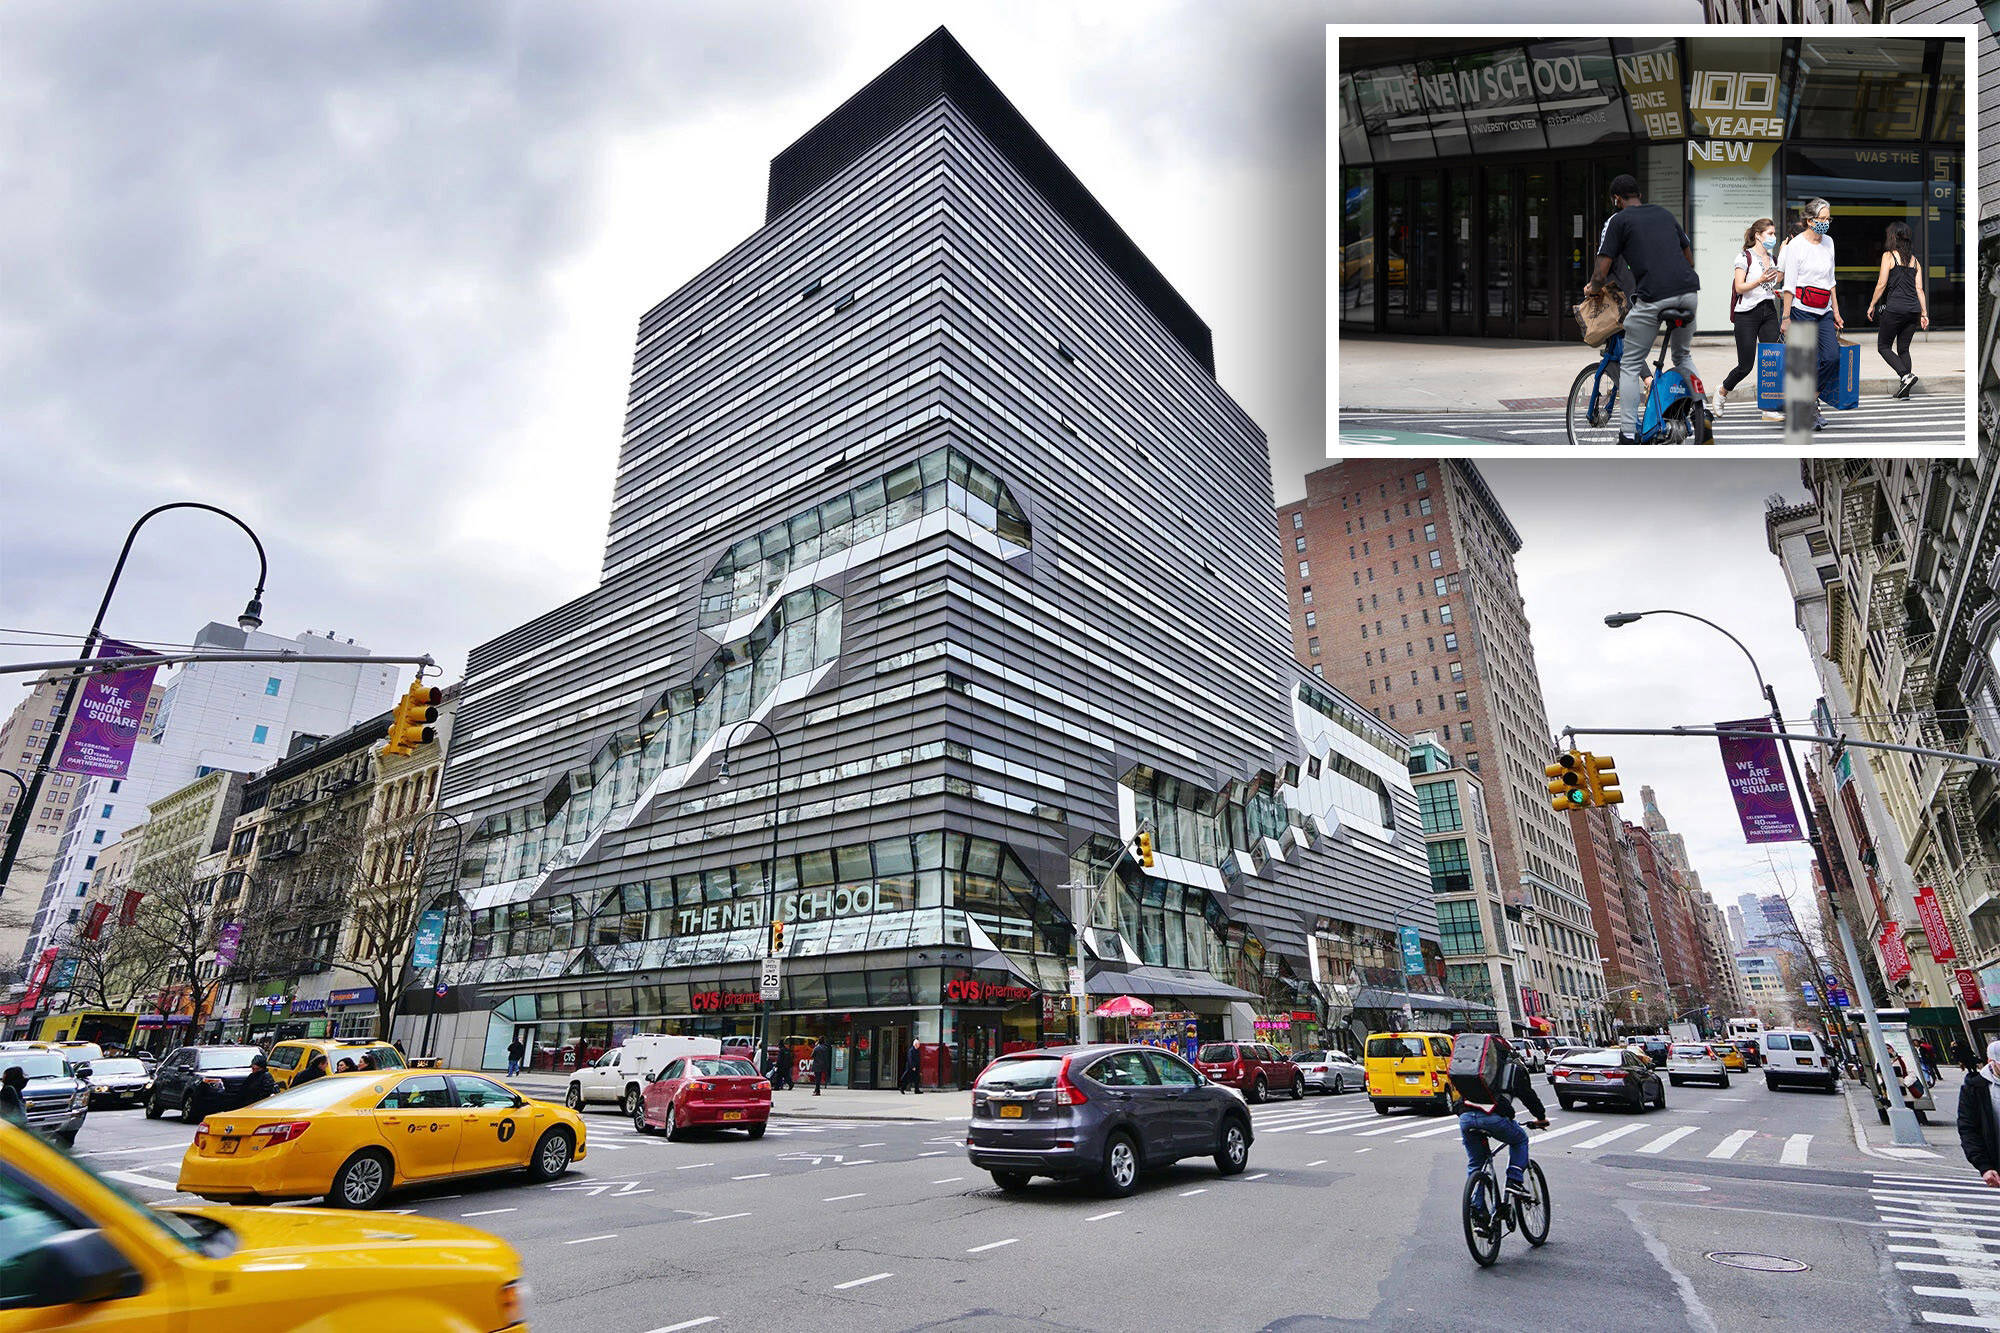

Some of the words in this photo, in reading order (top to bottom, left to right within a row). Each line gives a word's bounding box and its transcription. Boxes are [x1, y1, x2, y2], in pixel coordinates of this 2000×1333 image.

[1616, 52, 1675, 86] NEW
[1374, 78, 1424, 113] THE
[1420, 69, 1480, 108] NEW
[1483, 56, 1599, 101] SCHOOL
[1689, 71, 1777, 111] 100
[1630, 91, 1668, 110] SINCE
[1470, 121, 1508, 134] UNIVERSITY
[1509, 119, 1537, 131] CENTER
[1644, 112, 1682, 137] 1919
[1705, 116, 1784, 136] YEARS
[1688, 140, 1753, 162] NEW
[1855, 151, 1887, 163] WAS
[1891, 152, 1920, 164] THE
[1934, 187, 1952, 198] OF
[100, 684, 119, 697] WE
[83, 699, 122, 715] UNION
[107, 696, 132, 709] ARE
[89, 710, 138, 728] SQUARE
[75, 741, 110, 751] CELEBRATING
[80, 747, 94, 755] 40
[67, 757, 118, 769] PARTNERSHIPS
[84, 755, 124, 765] COMMUNITY
[1736, 761, 1754, 770] WE
[1749, 768, 1771, 777] ARE
[1731, 777, 1766, 787] UNION
[1741, 783, 1786, 795] SQUARE
[679, 906, 719, 934] THE
[721, 898, 780, 928] NEW
[784, 884, 894, 922] SCHOOL
[763, 974, 778, 987] 25
[948, 979, 1034, 1001] CVS/pharmacy
[563, 1052, 576, 1063] CVS
